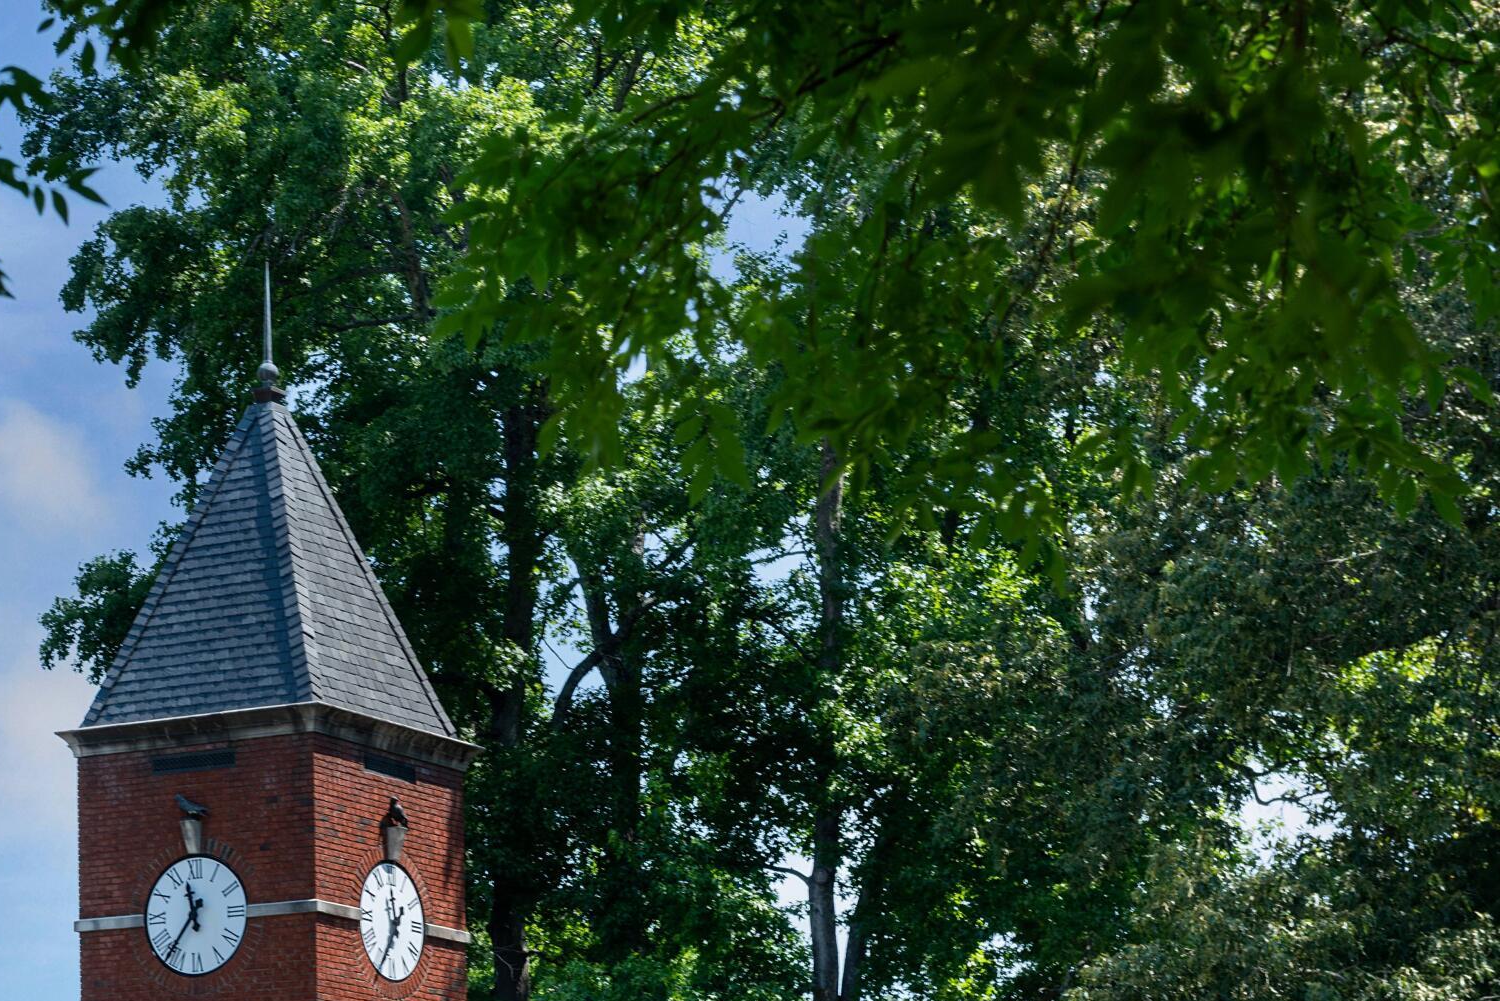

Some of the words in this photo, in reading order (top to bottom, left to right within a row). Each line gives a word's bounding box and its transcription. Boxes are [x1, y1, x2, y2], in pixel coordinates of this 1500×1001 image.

[166, 867, 184, 890] XI
[187, 859, 203, 880] XII
[221, 880, 240, 898] II
[149, 912, 166, 926] IX
[227, 905, 245, 918] III
